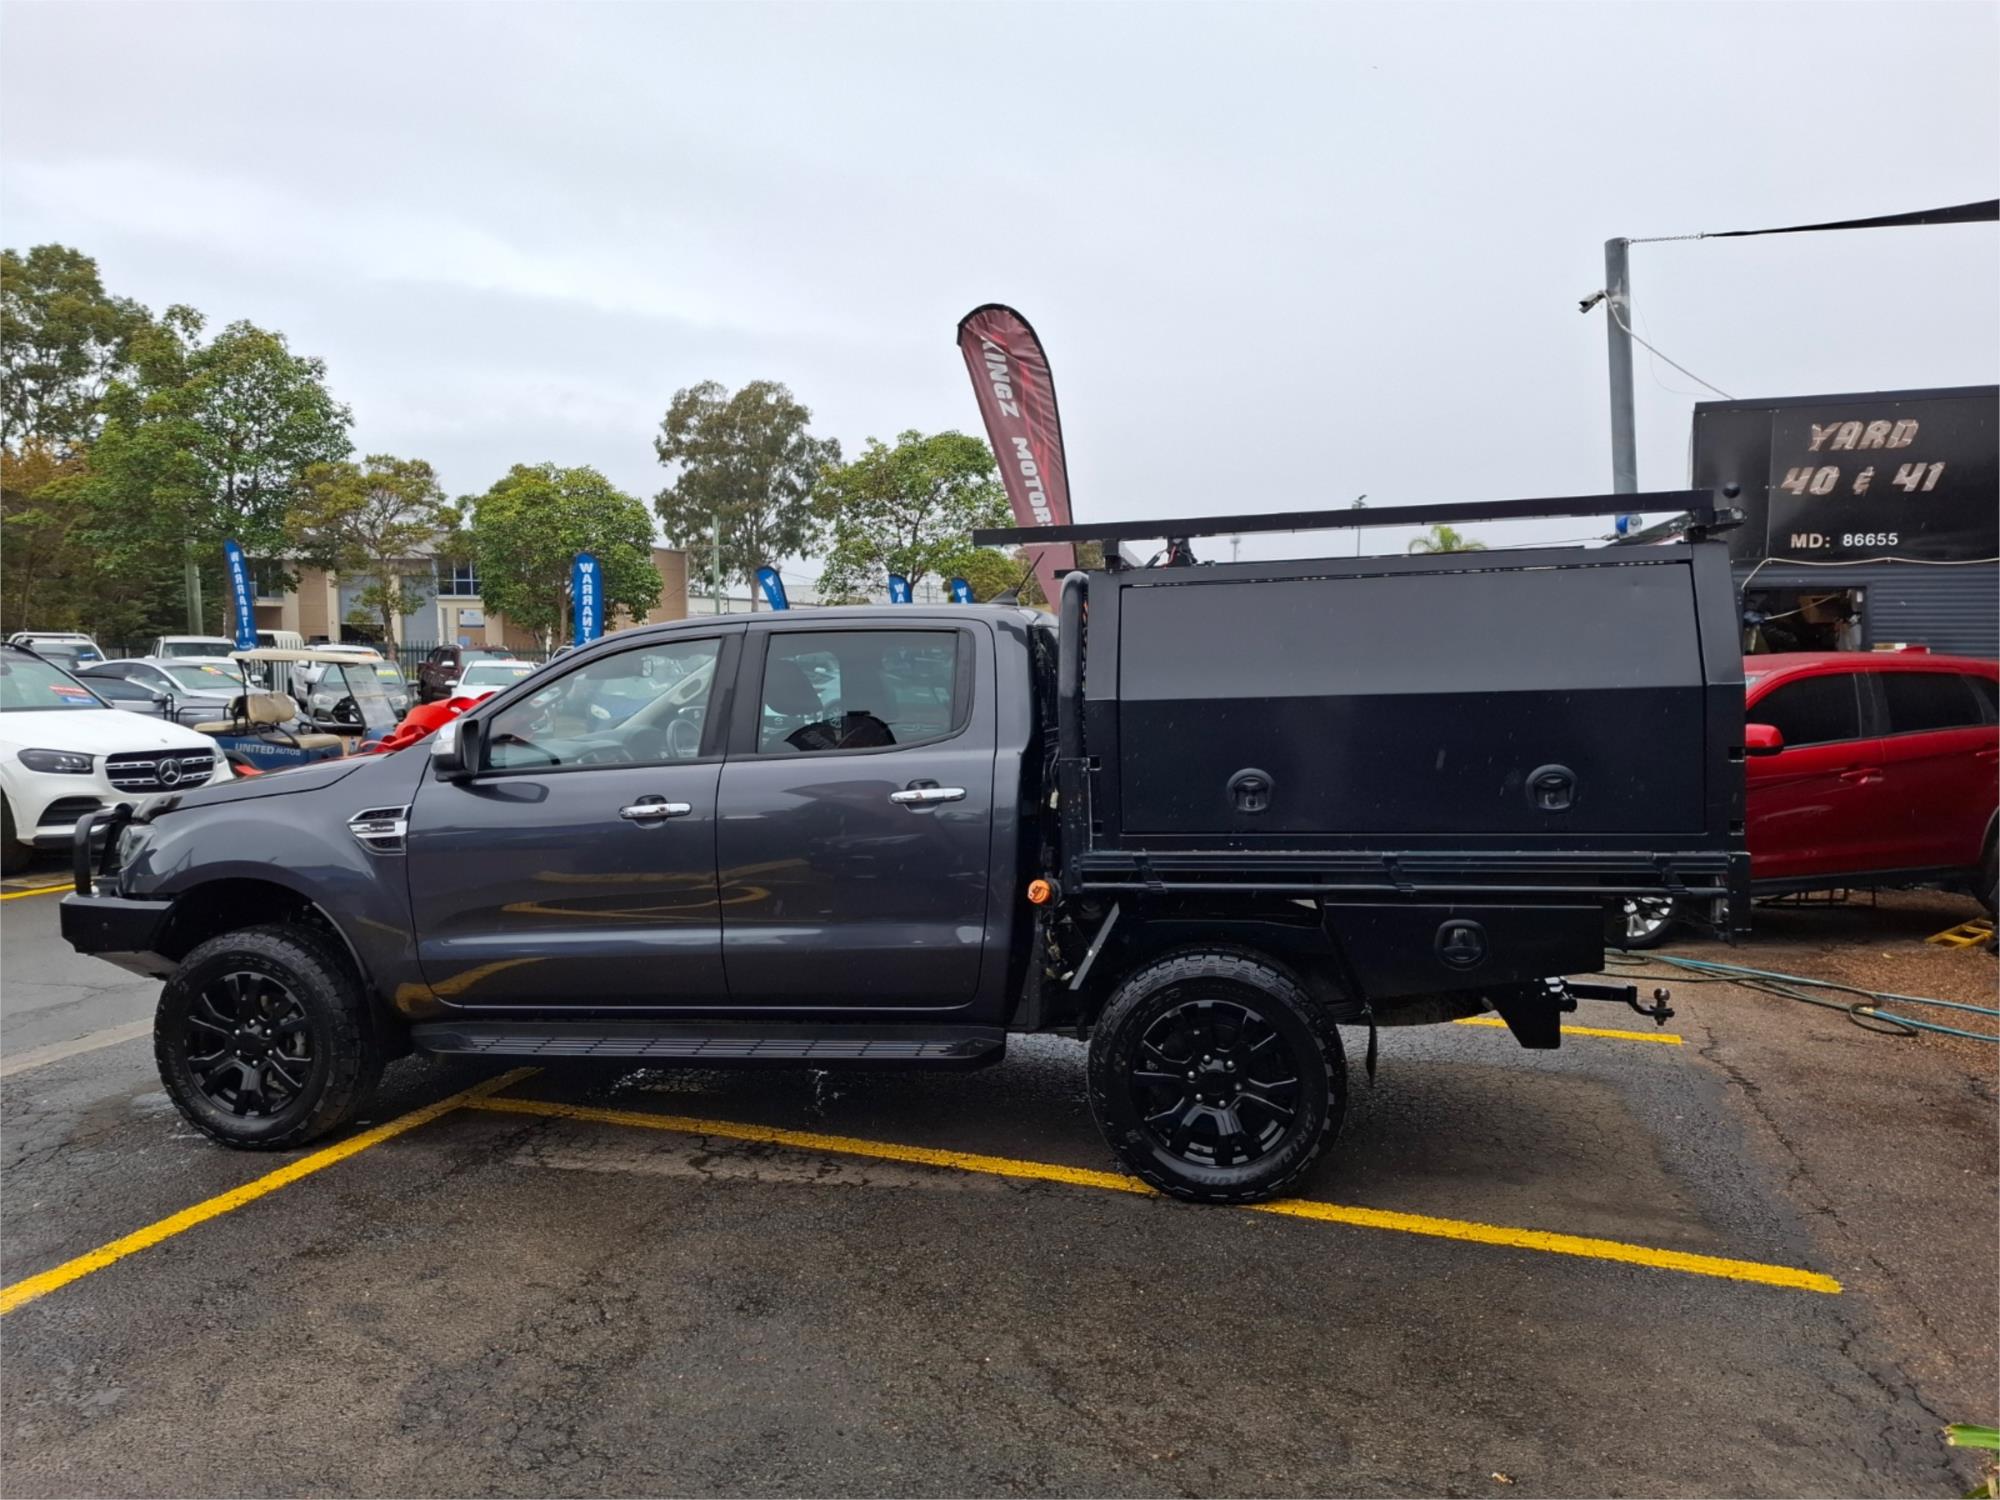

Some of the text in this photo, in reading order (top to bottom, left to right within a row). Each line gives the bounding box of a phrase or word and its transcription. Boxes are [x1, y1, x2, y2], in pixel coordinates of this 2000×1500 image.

[1808, 418, 1919, 451] YARD
[1011, 436, 1054, 526] MOTOR
[1781, 461, 1946, 496] 40 & 41
[1790, 532, 1898, 548] MD: 86655
[235, 743, 301, 756] UNITED AUTOS
